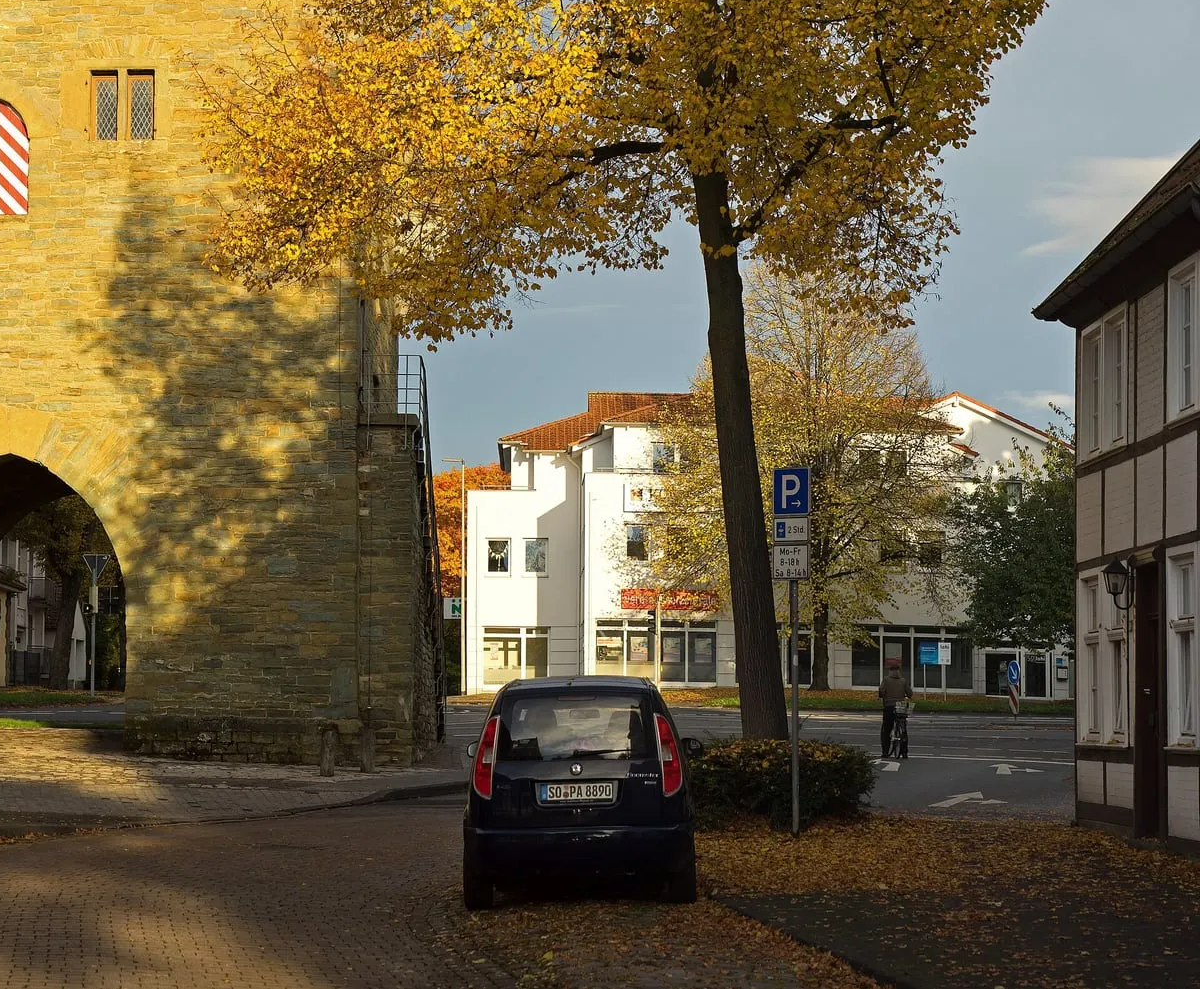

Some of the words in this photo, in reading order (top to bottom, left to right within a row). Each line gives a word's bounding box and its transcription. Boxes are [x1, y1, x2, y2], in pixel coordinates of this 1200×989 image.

[781, 474, 801, 509] P
[788, 526, 792, 534] 2
[779, 547, 801, 556] Mo-Fr
[775, 569, 784, 577] Sa
[786, 569, 802, 577] 8-14
[548, 786, 561, 799] SO
[569, 785, 583, 798] PA
[585, 784, 611, 798] 8890
